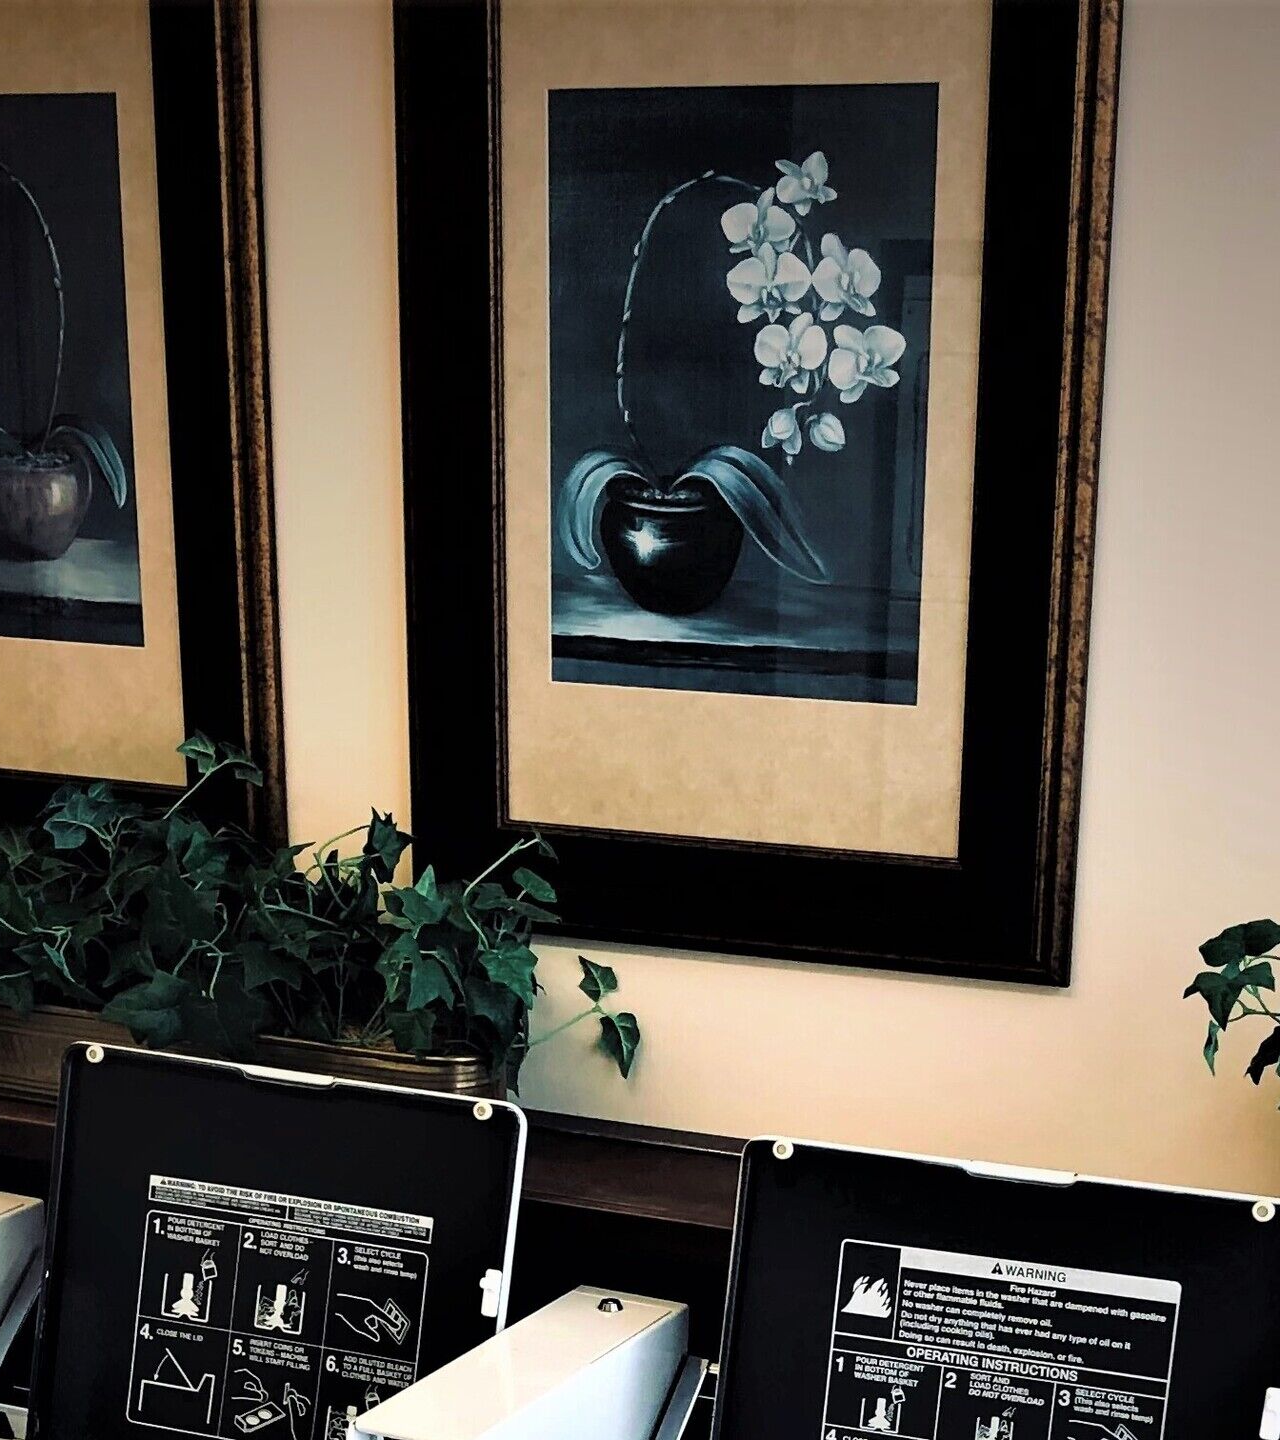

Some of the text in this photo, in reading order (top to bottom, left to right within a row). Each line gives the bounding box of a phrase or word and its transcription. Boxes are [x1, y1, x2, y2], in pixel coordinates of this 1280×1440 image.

[153, 1218, 165, 1235] 1.
[243, 1232, 258, 1250] 2.
[337, 1247, 351, 1265] 3.
[1005, 1265, 1067, 1283] WARNING
[139, 1323, 154, 1340] 4.
[232, 1338, 246, 1356] 5.
[325, 1355, 340, 1373] 6.
[835, 1356, 844, 1373] 1
[906, 1346, 1078, 1382] OPERATING INSTRUCTIONS
[944, 1371, 957, 1389] 2
[1058, 1389, 1071, 1407] 3
